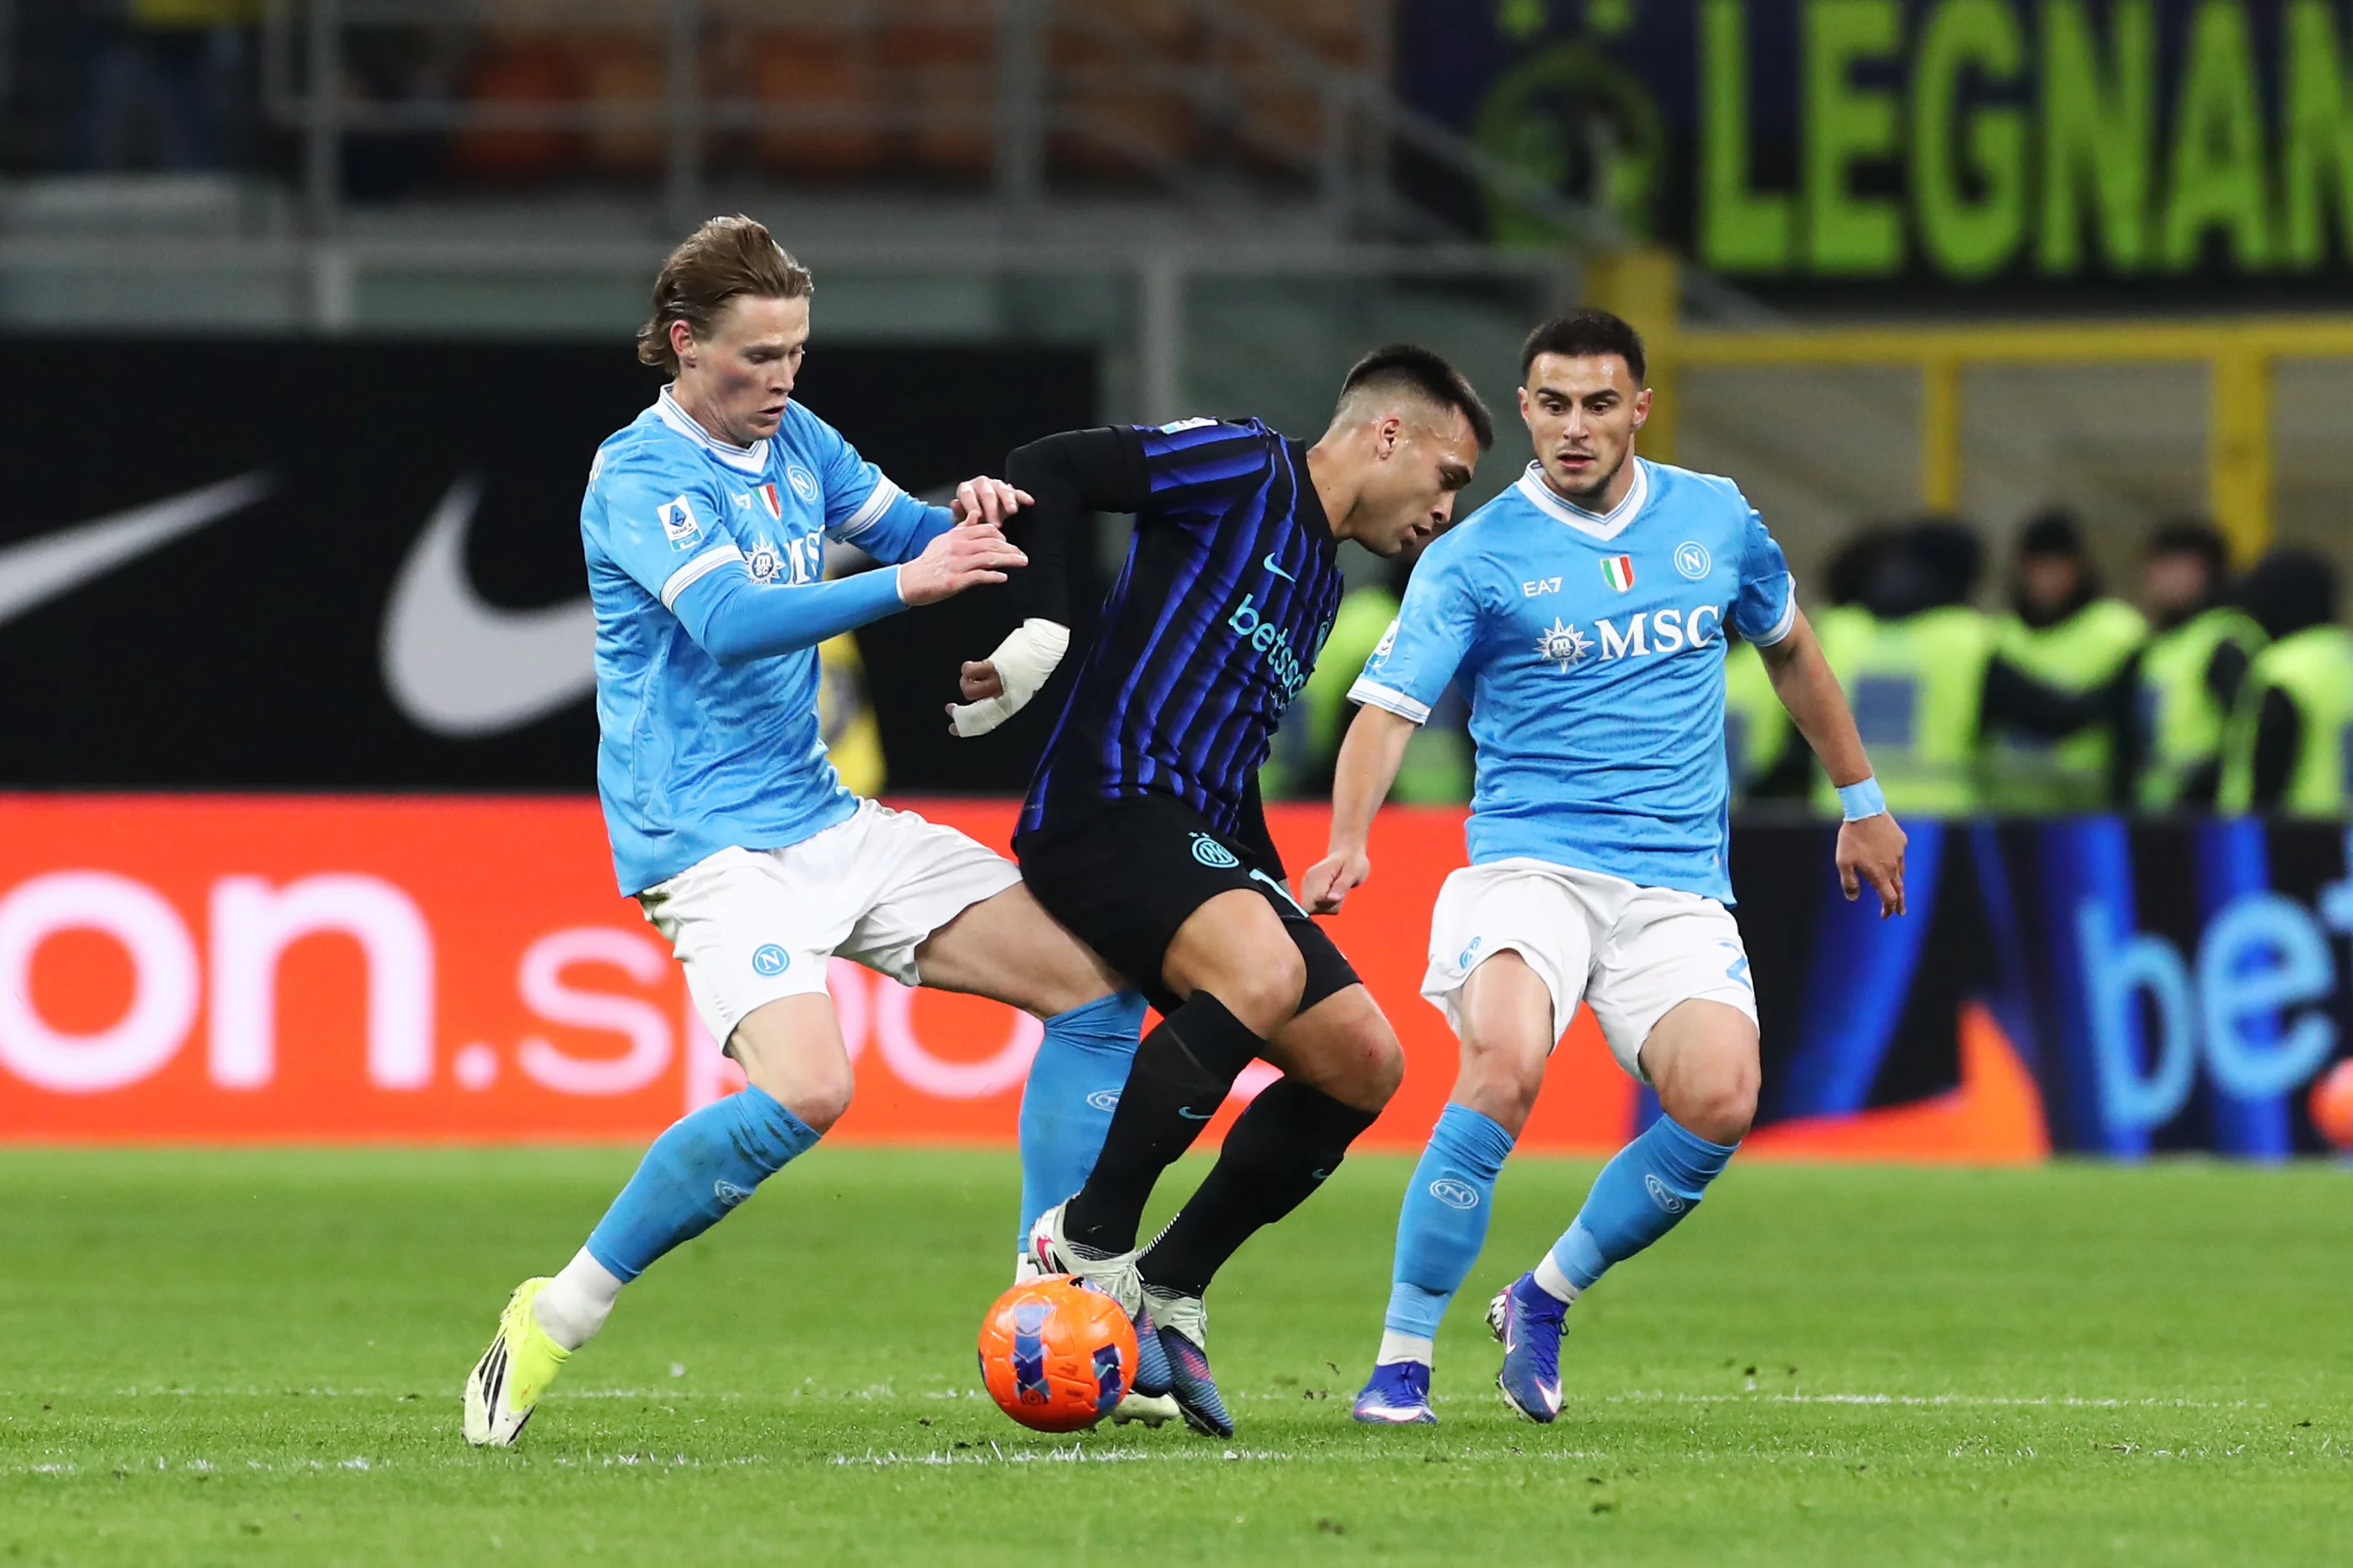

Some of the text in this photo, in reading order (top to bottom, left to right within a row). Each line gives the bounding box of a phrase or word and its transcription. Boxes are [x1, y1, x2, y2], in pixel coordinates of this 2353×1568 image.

[1523, 577, 1562, 598] EA7
[1594, 604, 1719, 662] MSC
[2075, 829, 2353, 1129] be
